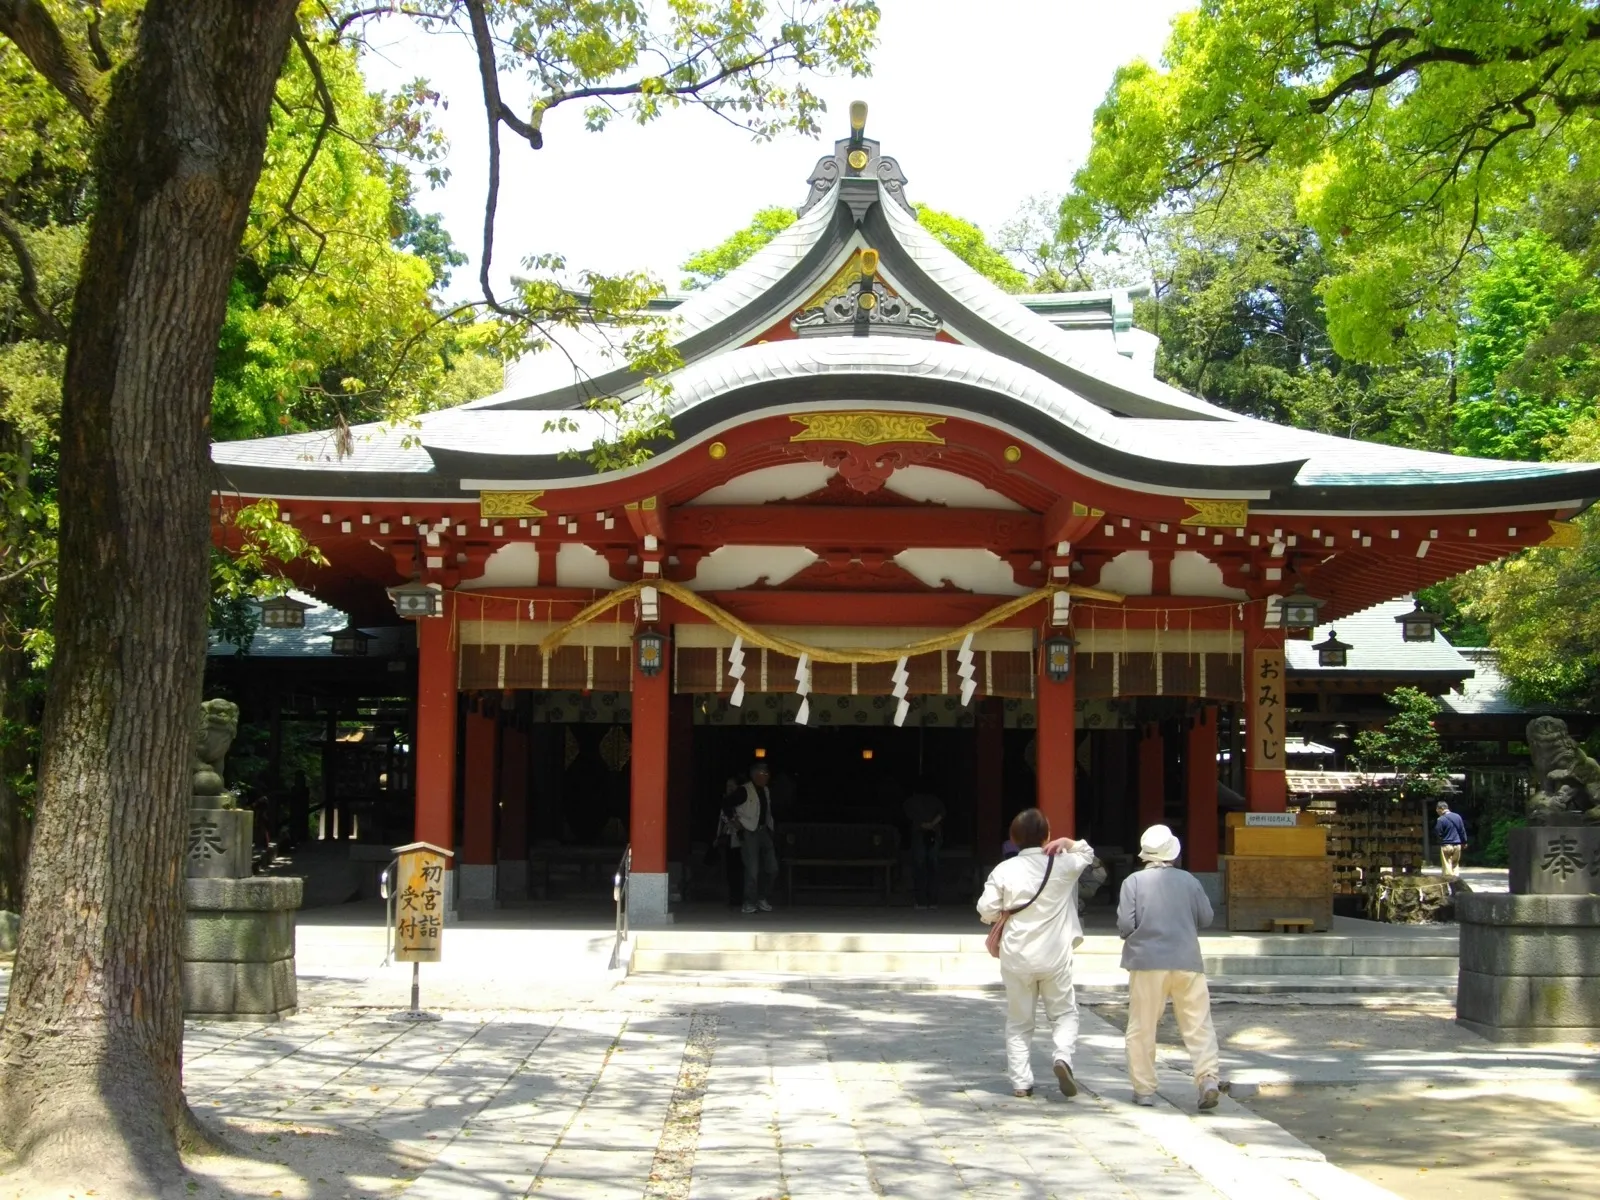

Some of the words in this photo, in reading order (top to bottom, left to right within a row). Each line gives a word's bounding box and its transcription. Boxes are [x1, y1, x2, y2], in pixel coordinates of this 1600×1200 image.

[1259, 659, 1279, 760] おみくじ
[398, 886, 419, 940] 受付
[419, 861, 443, 938] 初宮詣
